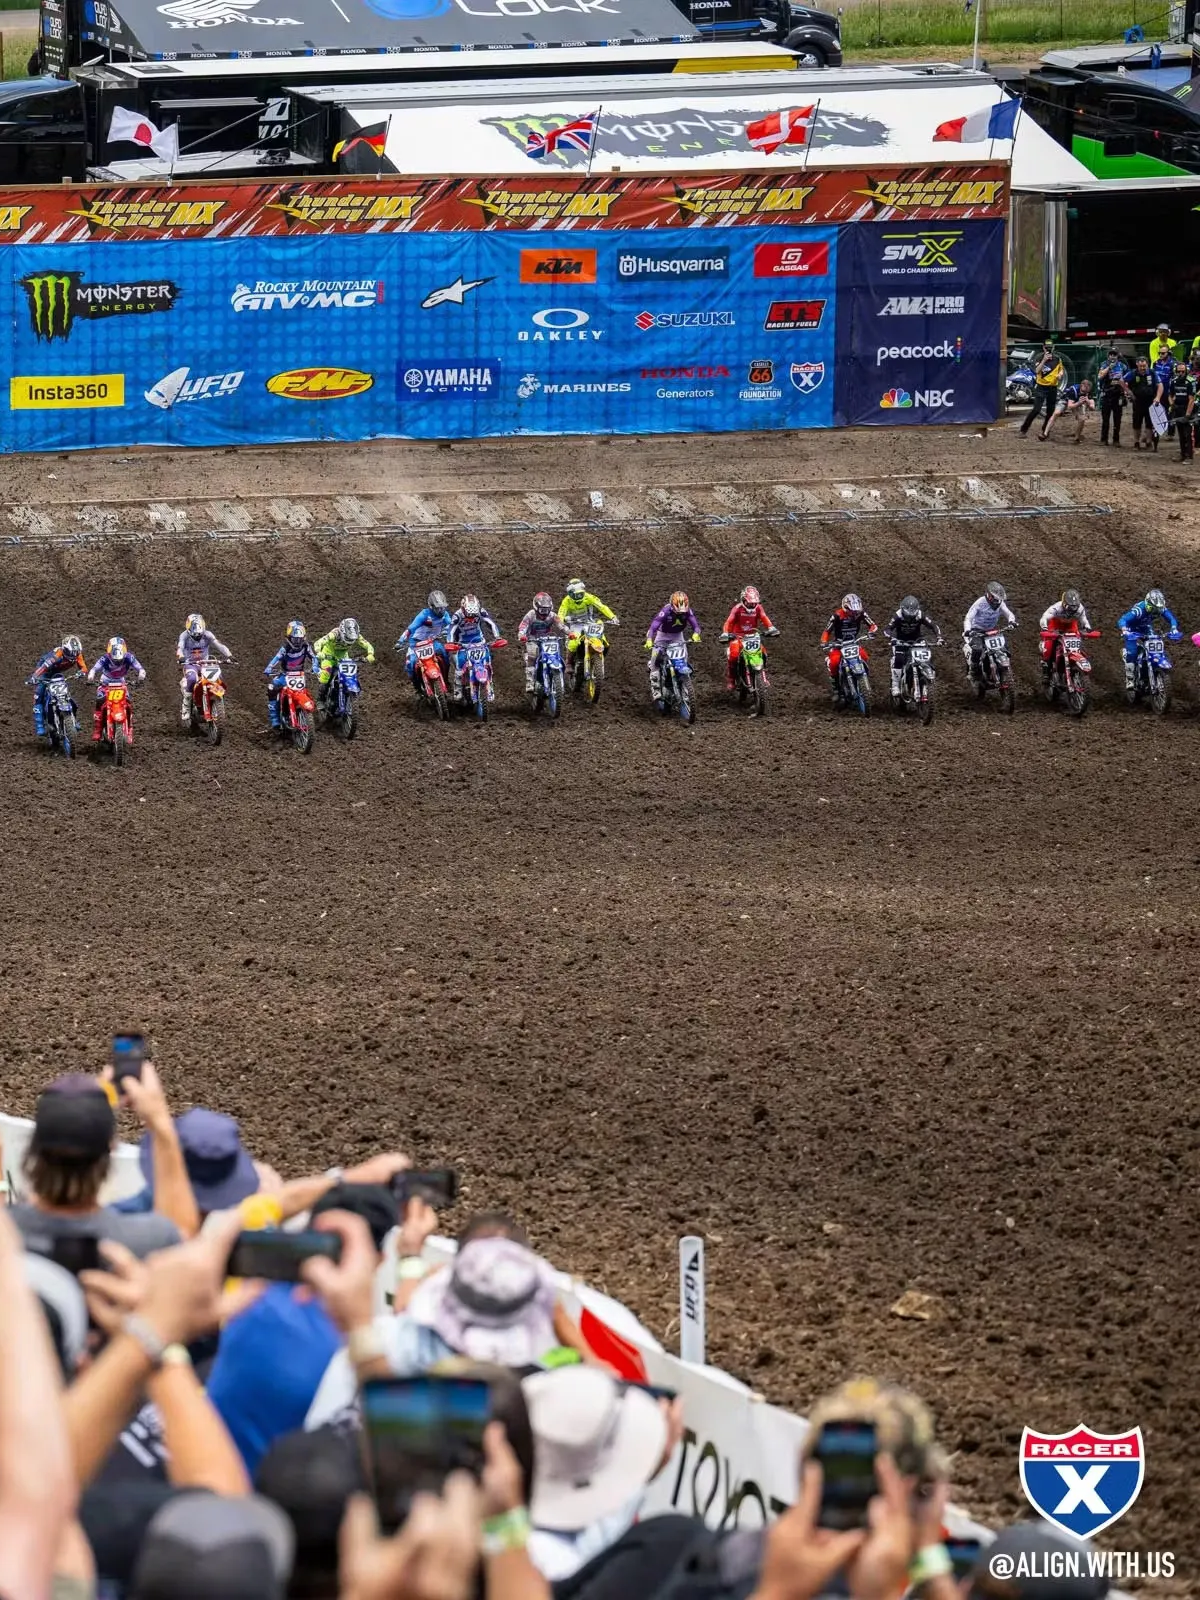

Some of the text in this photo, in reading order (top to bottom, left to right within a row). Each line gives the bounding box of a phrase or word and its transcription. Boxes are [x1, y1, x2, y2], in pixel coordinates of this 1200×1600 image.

[689, 1, 732, 10] HONDA
[166, 12, 305, 29] HONDA
[597, 112, 866, 142] MONSR
[682, 186, 768, 201] Thunder
[876, 180, 962, 195] Thunder
[886, 181, 1003, 209] Valley MX
[290, 194, 378, 209] Thunder
[487, 191, 575, 205] Thunder
[693, 187, 813, 214] Valley MX
[90, 201, 178, 215] Thunder
[301, 195, 422, 222] Valley MX
[498, 193, 619, 219] Valley MX
[102, 202, 225, 229] Valley MX
[882, 238, 957, 266] SMX
[534, 257, 583, 275] KTM
[638, 257, 725, 274] Husqvarna
[772, 264, 809, 272] GASGAS
[907, 266, 958, 274] CHAMPIONSHIP
[76, 284, 173, 303] MONSTER
[255, 281, 298, 294] ROCKY
[302, 279, 377, 292] MOUNTAIN
[90, 303, 157, 312] ENERGY
[768, 302, 825, 321] ETS
[877, 296, 965, 316] AMA PRO
[657, 312, 734, 327] SUZUKI
[766, 321, 795, 329] RACING
[518, 330, 603, 341] OAKLEY
[877, 340, 955, 366] peacock
[424, 367, 492, 386] YAMAHA
[640, 365, 731, 379] HONDA
[751, 368, 771, 381] 66
[799, 372, 815, 387] X
[178, 371, 245, 397] UFO
[267, 371, 372, 392] FMF
[543, 382, 632, 394] MARINES
[28, 383, 108, 401] Insta360
[656, 388, 714, 399] Generators
[739, 390, 782, 399] FOUNDATION
[914, 389, 954, 408] NBC
[843, 646, 859, 658] 53
[913, 650, 930, 660] 42
[205, 668, 220, 680] 7
[341, 664, 357, 675] 37
[288, 679, 305, 690] 96
[107, 689, 125, 701] 18
